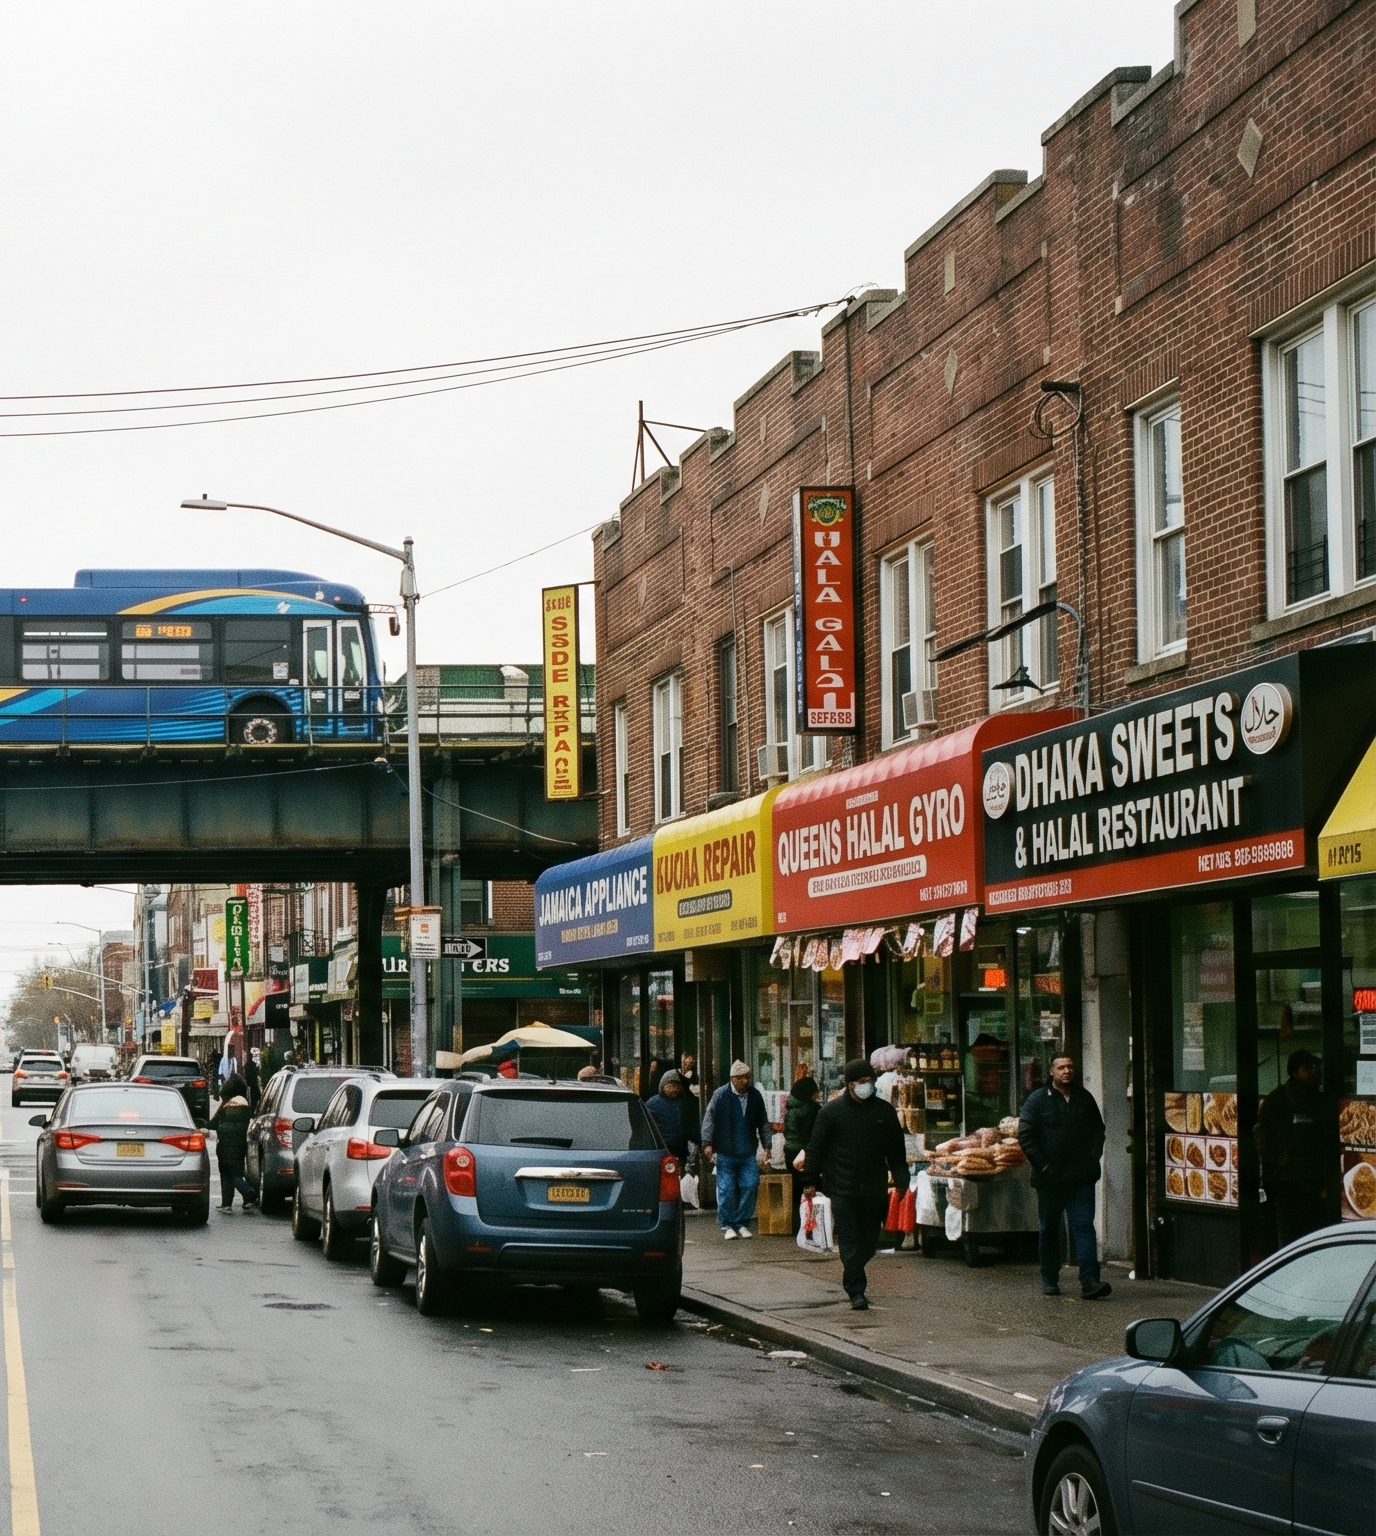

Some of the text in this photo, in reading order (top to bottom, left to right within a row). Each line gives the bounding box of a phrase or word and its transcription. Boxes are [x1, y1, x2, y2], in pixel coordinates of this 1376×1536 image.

[1015, 691, 1235, 812] DHAKA SWEETS
[704, 830, 756, 884] REPAIR
[777, 819, 842, 877] QUEENS
[846, 802, 905, 861] HALAL
[909, 783, 965, 847] GYRO
[1015, 776, 1246, 869] & HALAL RESTAURANT
[539, 884, 583, 927] JAMAICA
[585, 865, 648, 917] APPLIANCE
